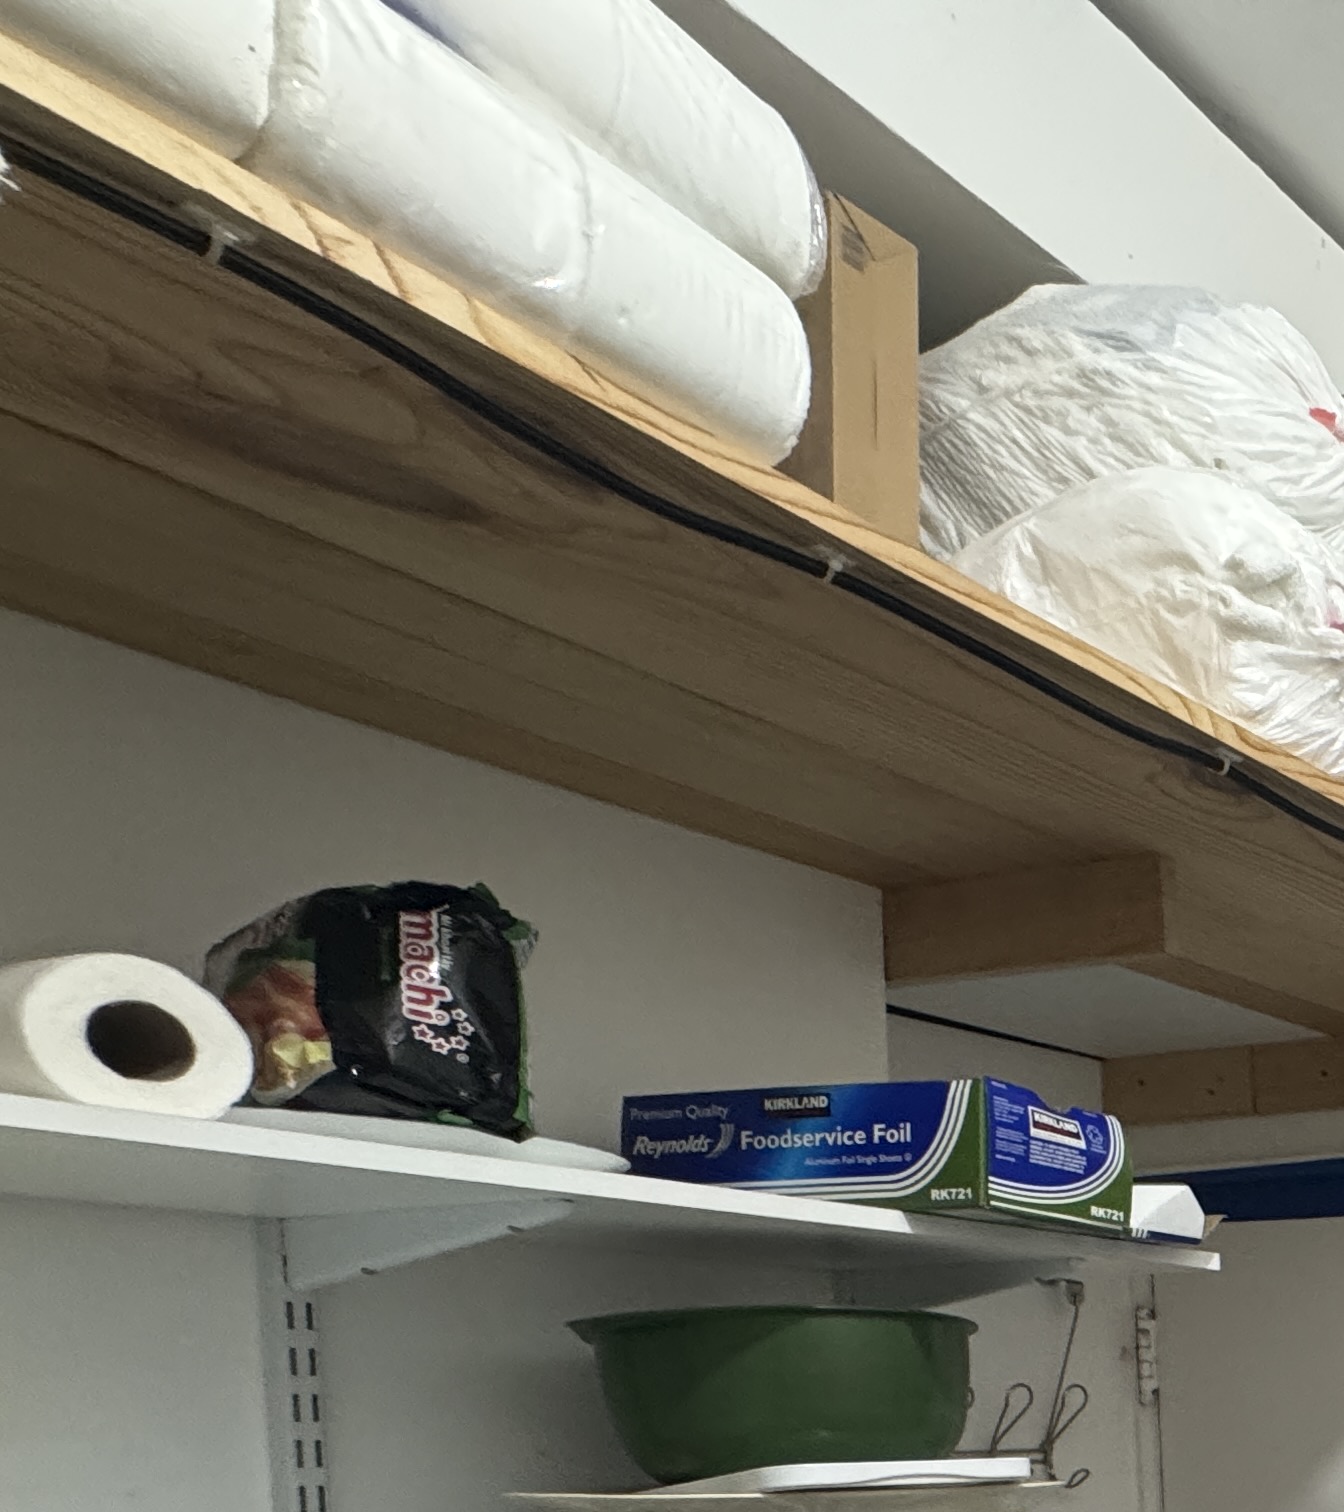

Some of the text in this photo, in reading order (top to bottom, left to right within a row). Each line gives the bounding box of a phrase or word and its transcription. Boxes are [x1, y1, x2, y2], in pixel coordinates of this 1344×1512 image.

[685, 1104, 730, 1120] Quality
[764, 1095, 829, 1111] KIRKLAND
[1033, 1111, 1078, 1133] KIRKLAND
[632, 1122, 912, 1159] Reynolds Foodservice Foil
[931, 1187, 973, 1201] RK721
[1090, 1206, 1125, 1221] RK721
